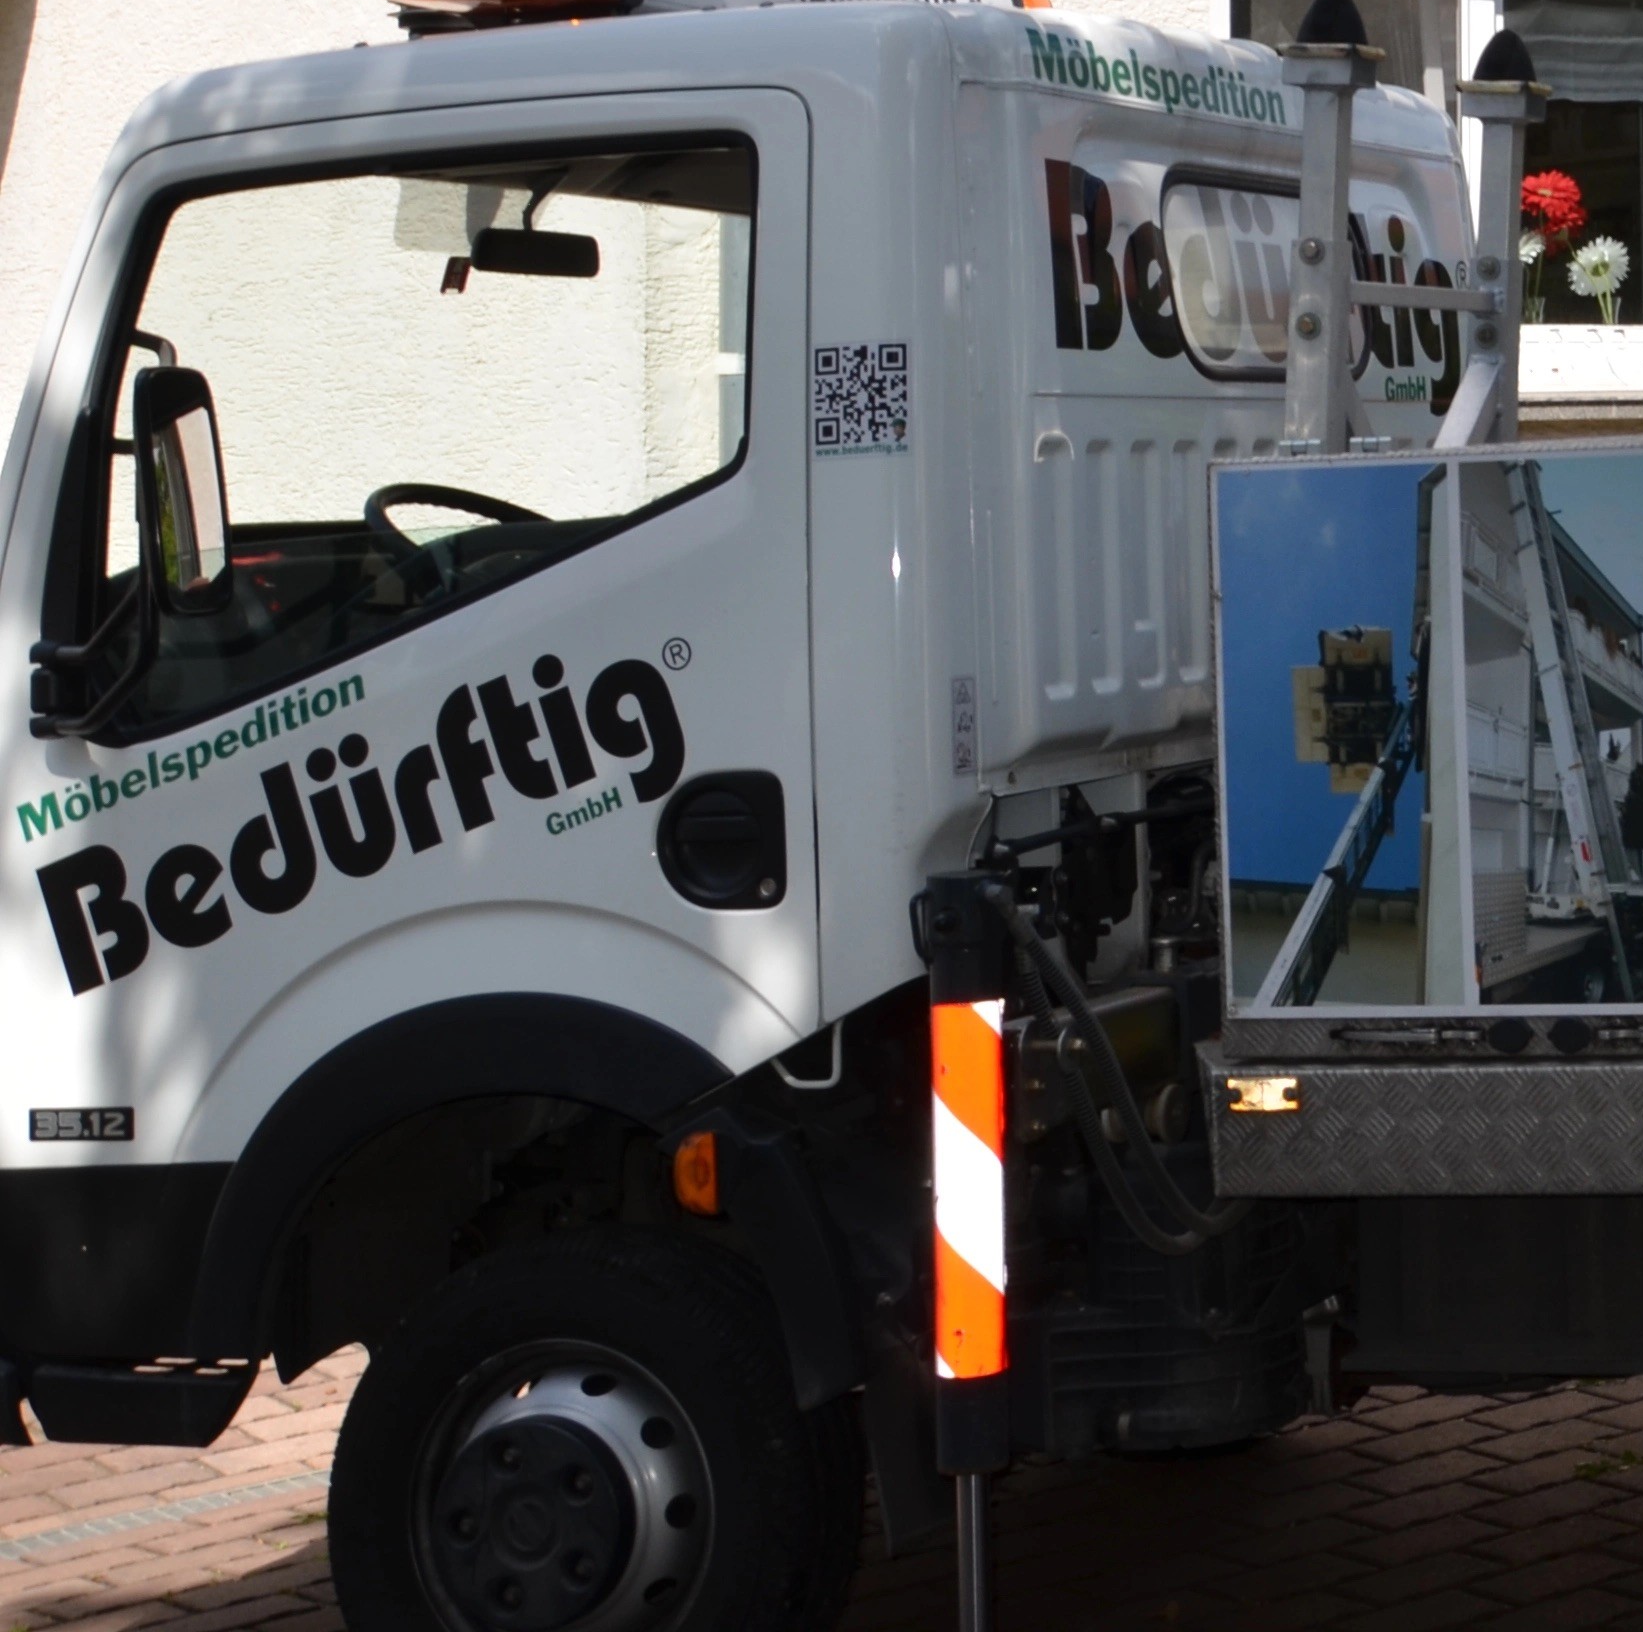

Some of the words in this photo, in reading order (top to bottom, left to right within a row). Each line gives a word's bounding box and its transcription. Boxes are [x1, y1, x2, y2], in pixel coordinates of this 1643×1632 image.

[1024, 27, 1287, 126] Möbelspedition
[1384, 375, 1427, 402] GmbH
[16, 673, 366, 842] Möbelspedition
[36, 653, 686, 997] Bedürftig
[546, 787, 624, 837] GmbH
[35, 1111, 125, 1138] 35.12
